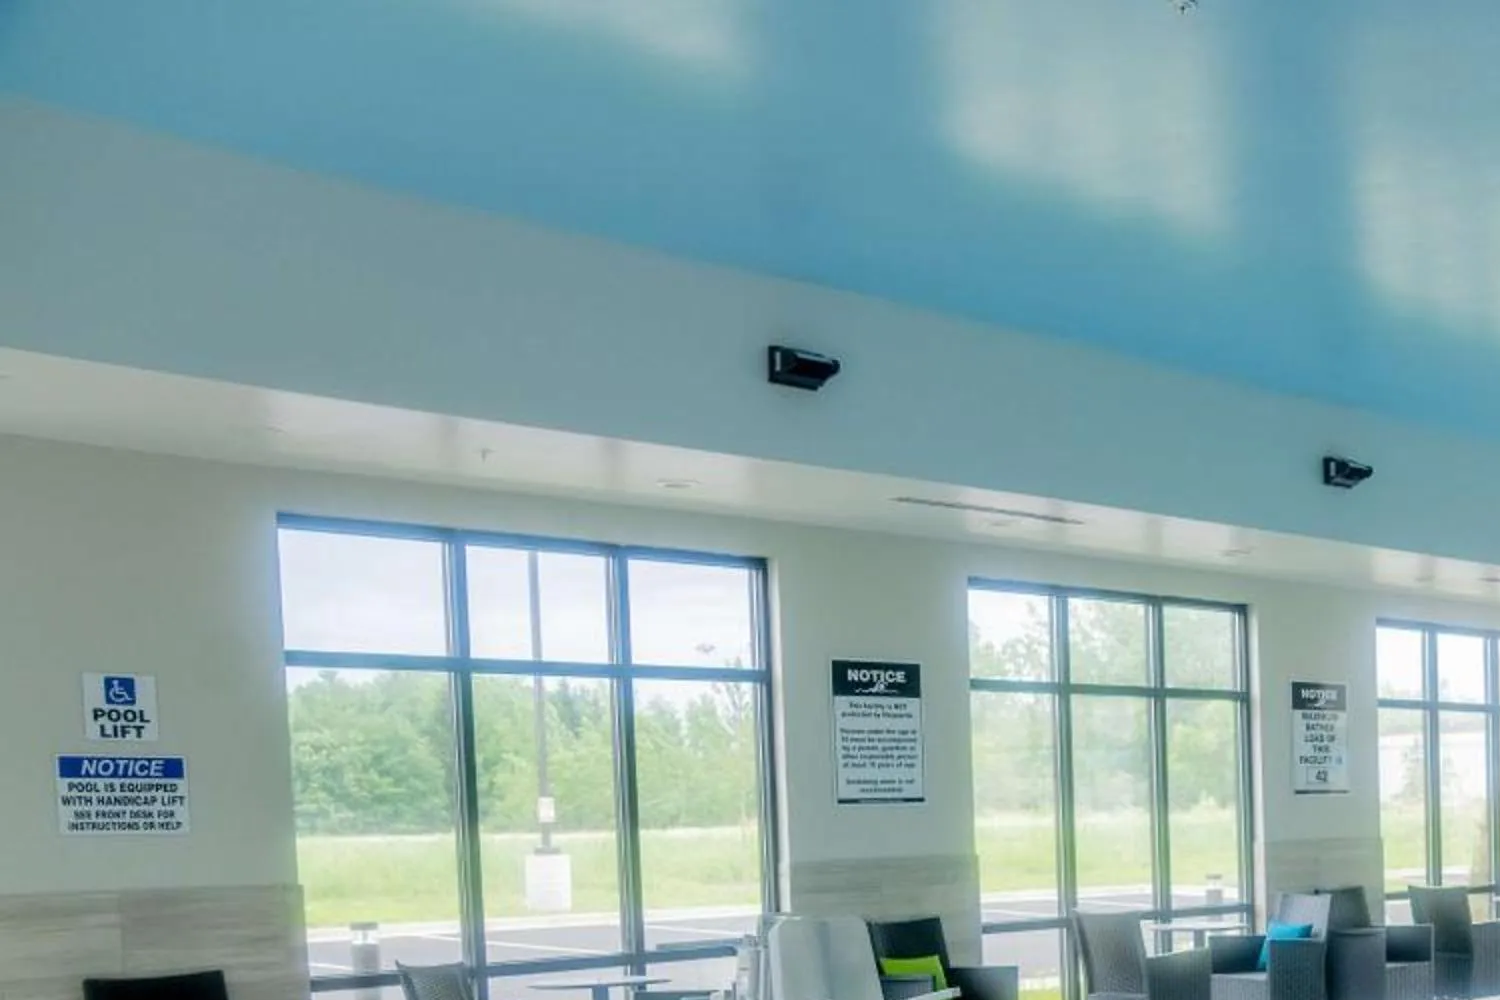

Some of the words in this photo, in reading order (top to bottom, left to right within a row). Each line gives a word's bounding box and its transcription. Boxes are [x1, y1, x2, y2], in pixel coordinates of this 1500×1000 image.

[847, 668, 906, 683] NOTICE
[93, 708, 150, 723] POOL
[100, 725, 145, 738] LIFT
[81, 759, 165, 776] NOTICE
[67, 782, 100, 793] POOL
[104, 783, 117, 793] IS
[120, 783, 178, 793] EQUIPPED
[61, 796, 93, 807] WITH
[97, 796, 158, 807] HANDICAP
[162, 796, 185, 807] LIFT
[74, 810, 91, 820] SEE
[95, 810, 127, 820] FRONT
[130, 810, 154, 820] DESK
[157, 811, 175, 820] FOR
[68, 821, 140, 832] INSTRUCTIONS
[143, 822, 157, 831] OR
[158, 822, 183, 832] HELP
